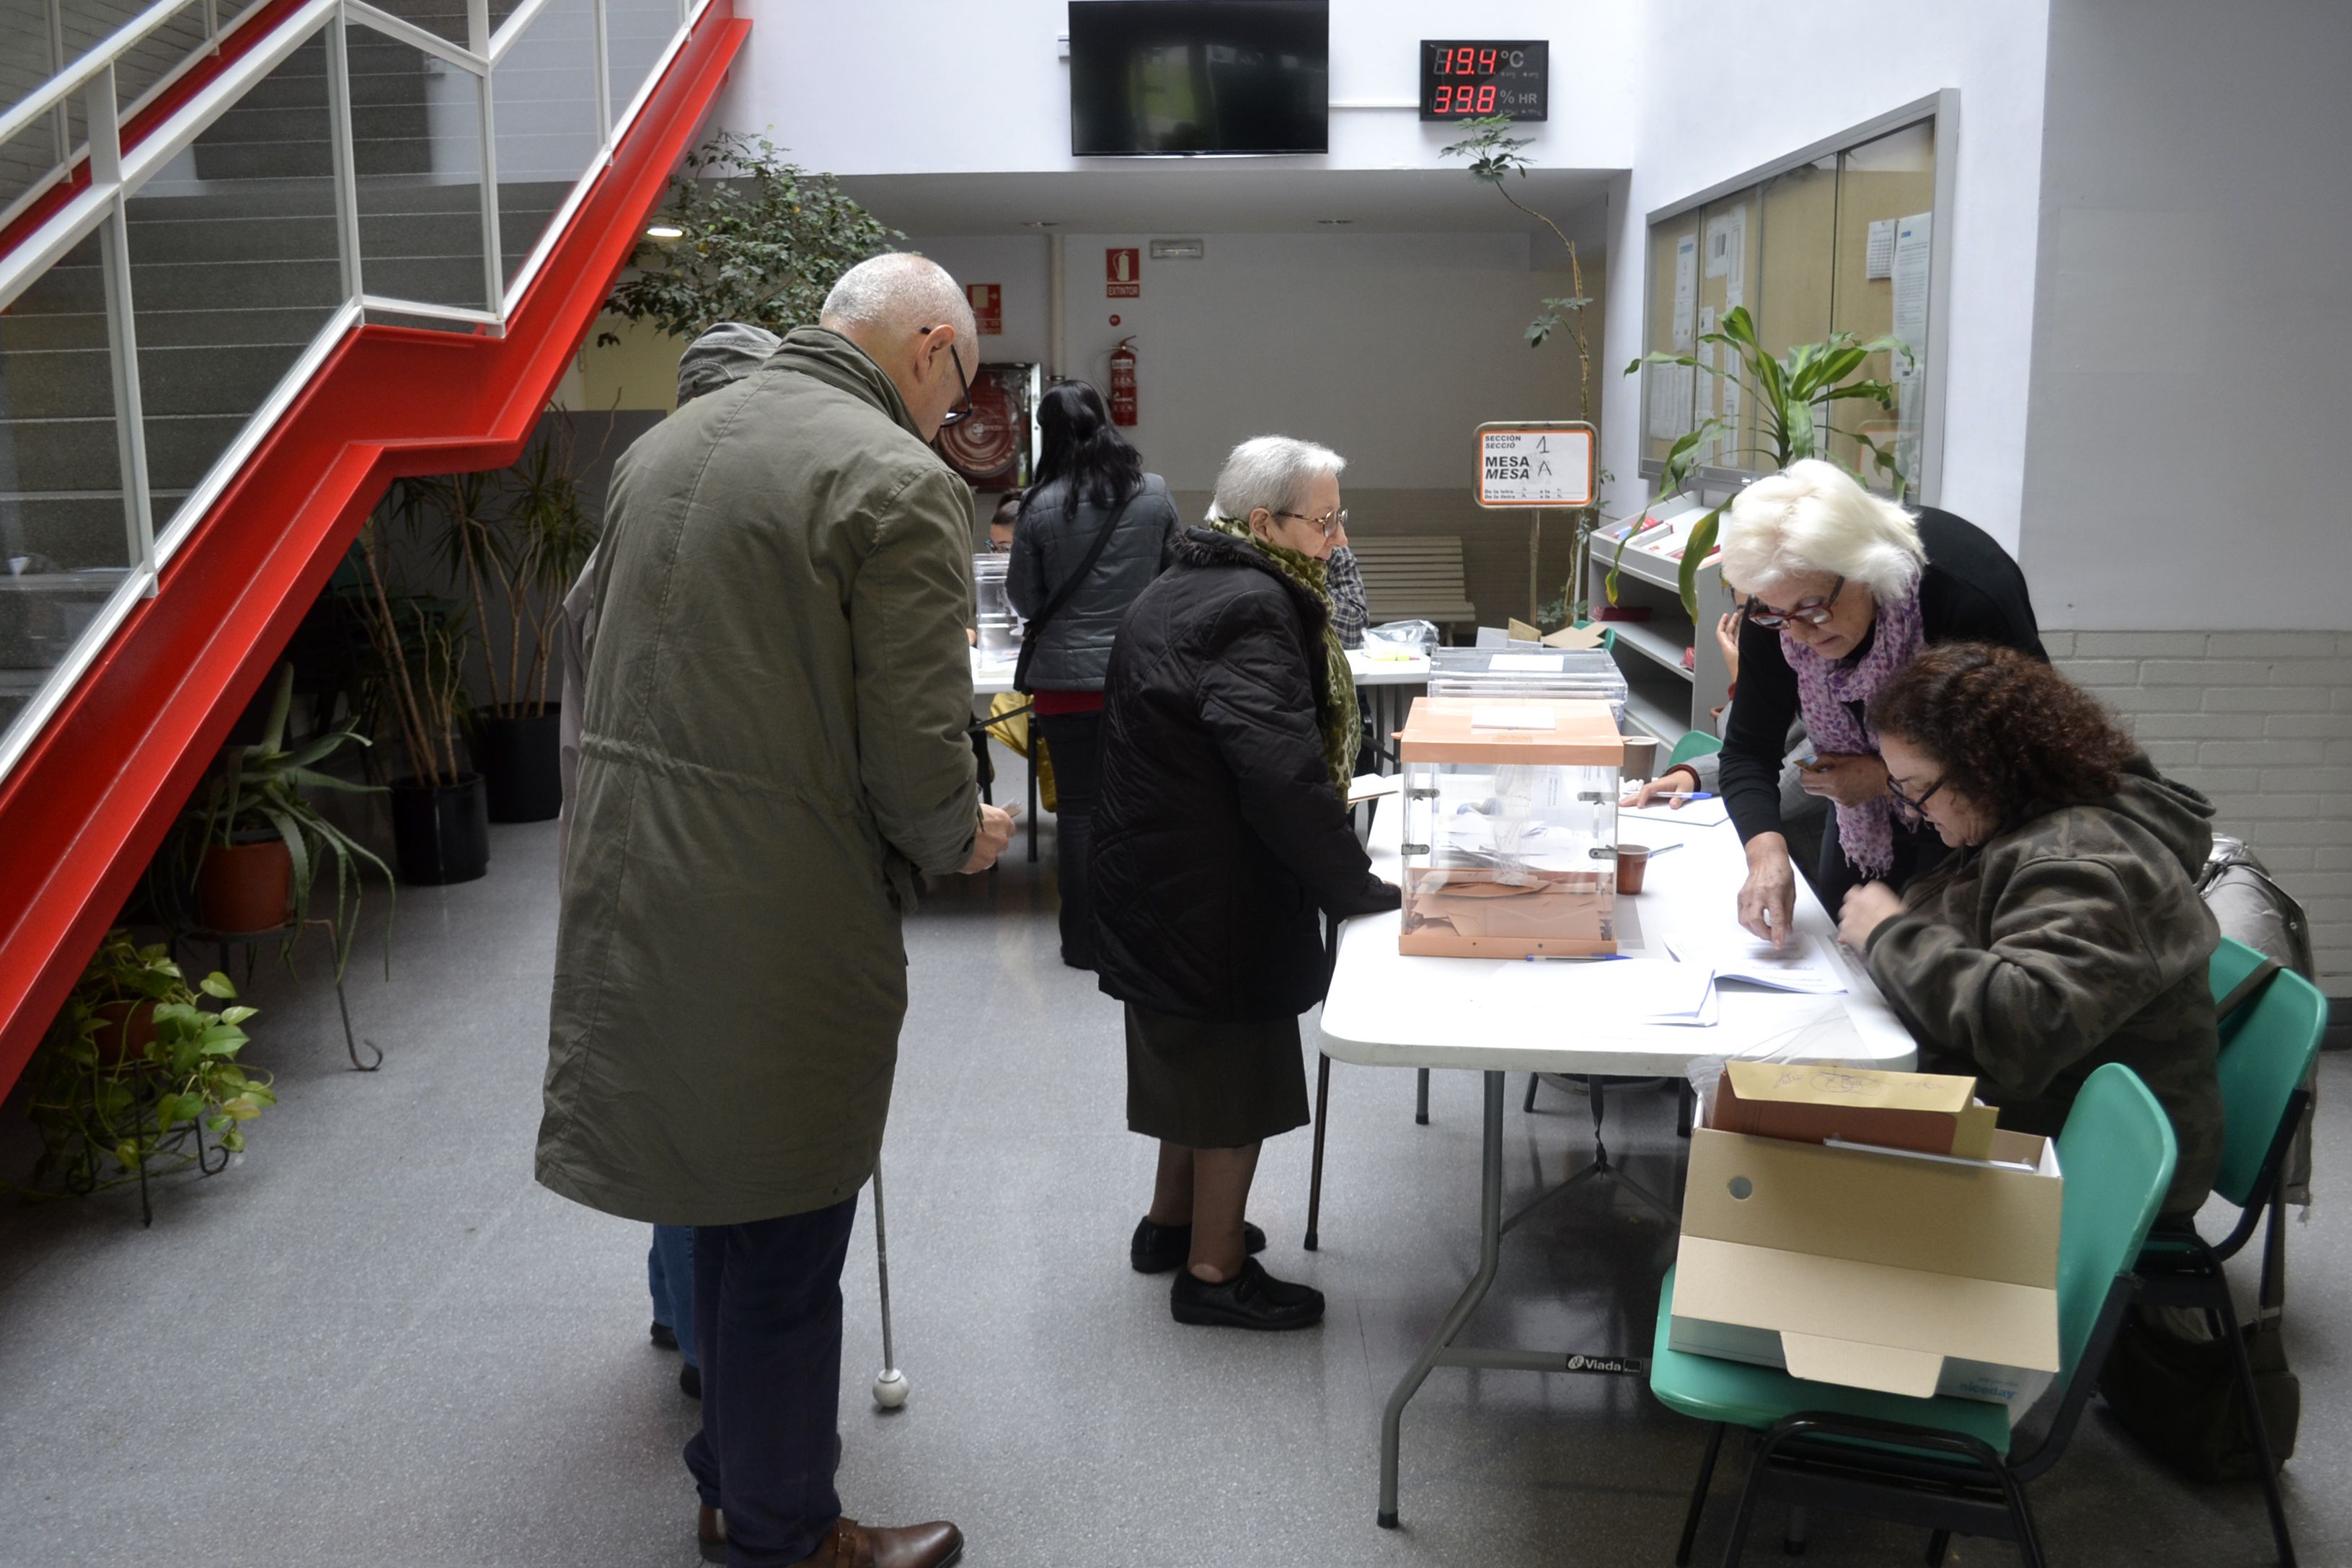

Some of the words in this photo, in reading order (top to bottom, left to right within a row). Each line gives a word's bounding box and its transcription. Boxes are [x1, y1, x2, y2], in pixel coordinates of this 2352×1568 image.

[1445, 48, 1497, 75] 19.4
[1433, 86, 1497, 113] 39.8
[1500, 89, 1514, 104] %
[1518, 93, 1537, 104] HR
[1108, 286, 1138, 296] EXTINTOR
[1536, 435, 1549, 453] 1
[1485, 456, 1530, 467] MESA
[1485, 469, 1530, 479] MESA
[1586, 1359, 1622, 1371] Viada
